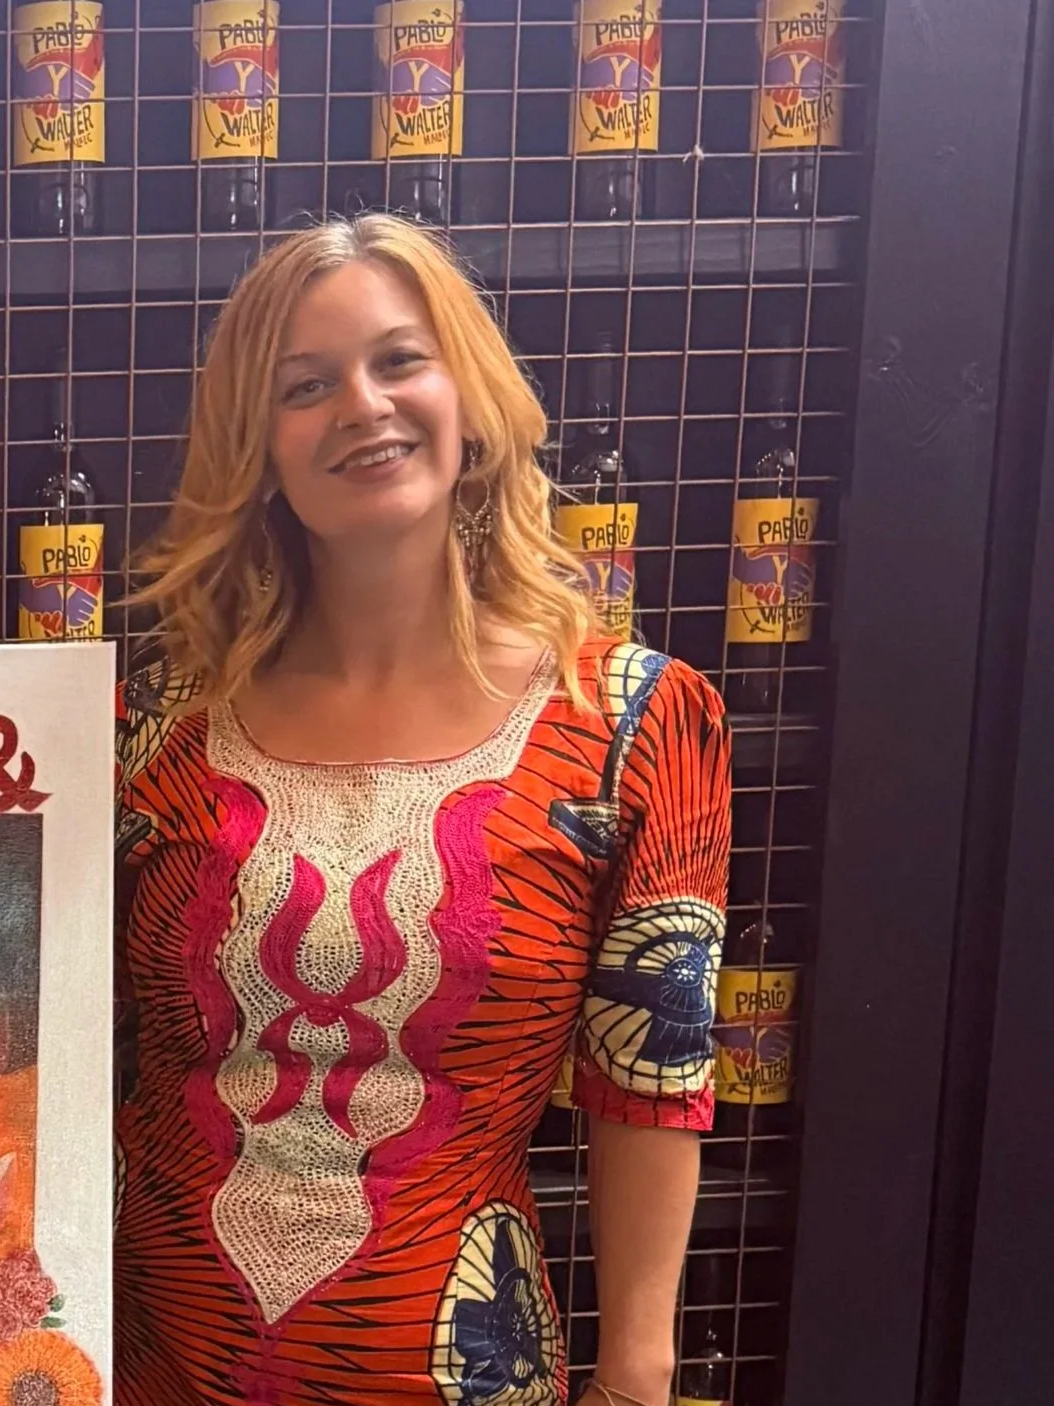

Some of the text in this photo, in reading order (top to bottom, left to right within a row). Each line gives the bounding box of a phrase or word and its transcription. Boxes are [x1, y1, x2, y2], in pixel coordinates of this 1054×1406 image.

[32, 20, 85, 54] PABLO
[394, 19, 447, 52] PABLO
[35, 104, 94, 141] WALTER
[221, 102, 275, 138] WALTR
[394, 98, 451, 137] WALTER
[600, 94, 653, 132] WALTR
[775, 91, 834, 129] WALTR
[582, 522, 629, 550] PABLO
[758, 516, 808, 544] PABLO
[42, 544, 91, 573] PABLO
[735, 988, 786, 1014] PABLO
